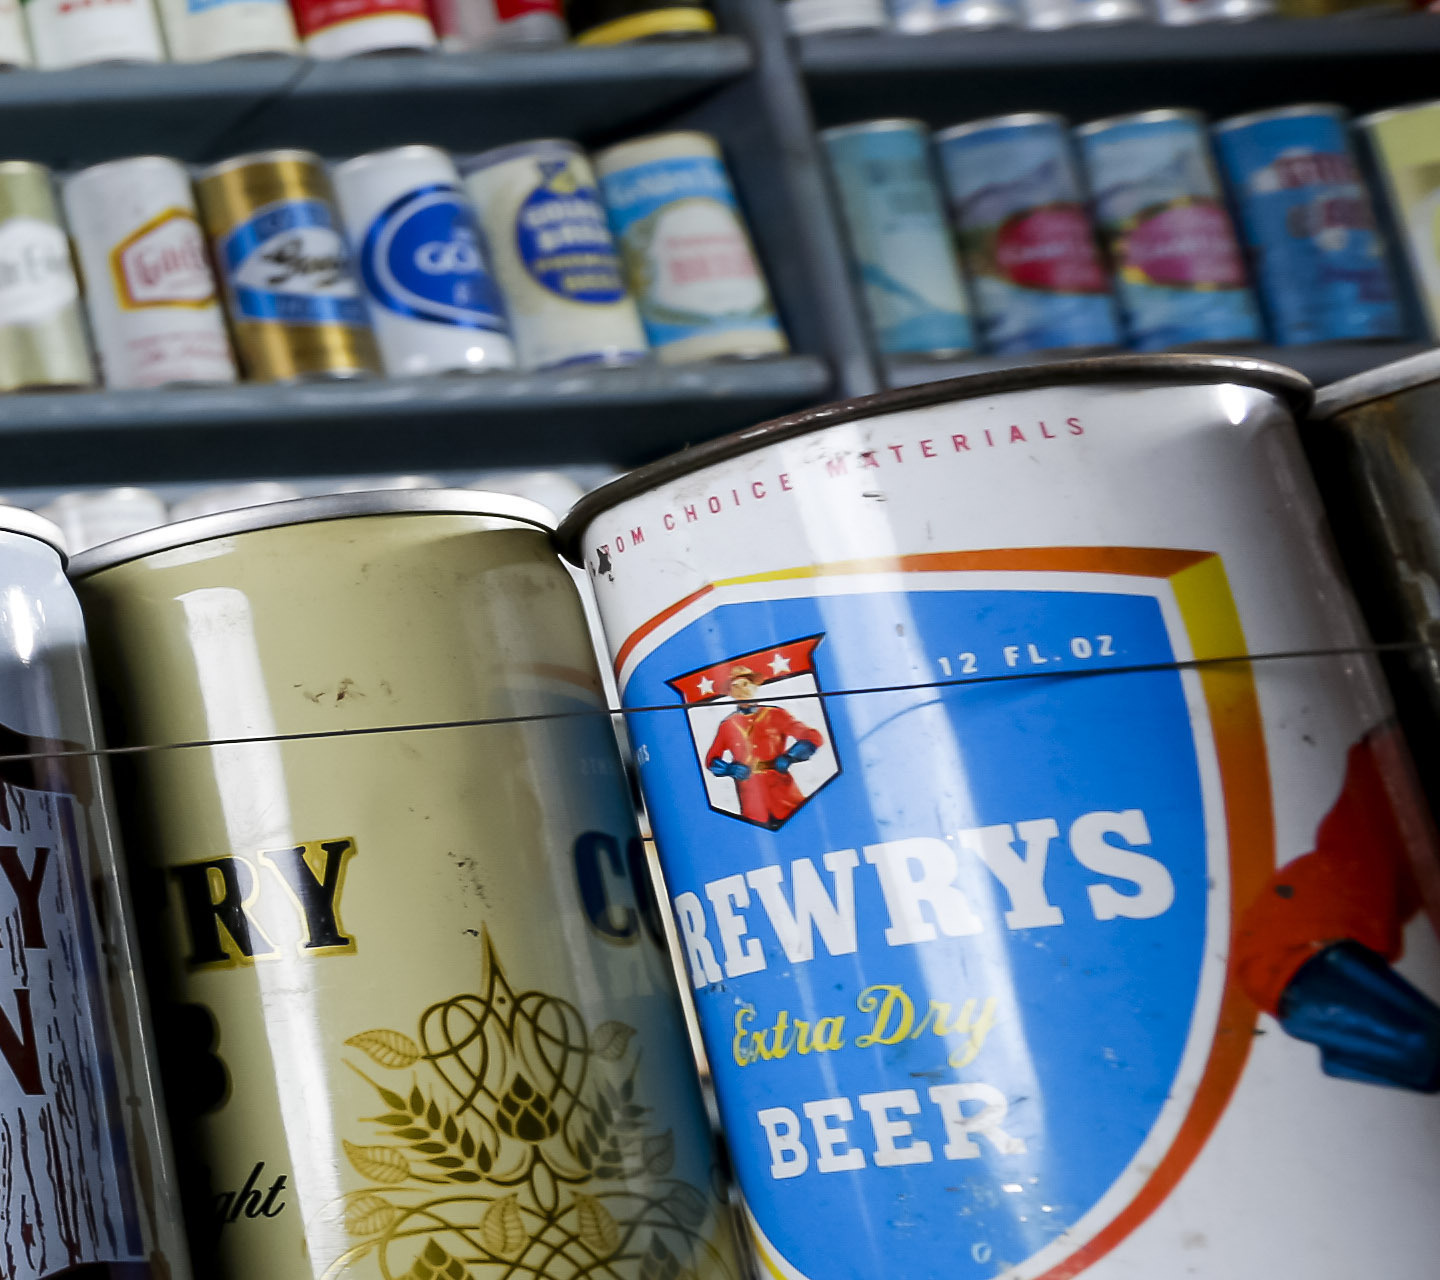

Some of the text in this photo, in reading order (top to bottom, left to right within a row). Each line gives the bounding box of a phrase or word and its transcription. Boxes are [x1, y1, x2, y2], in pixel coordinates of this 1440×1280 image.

[663, 415, 1087, 532] CHOICE MATERIALS
[937, 650, 979, 678] 12
[673, 807, 1177, 990] REWRYS
[732, 984, 1002, 1068] Extra Dry
[759, 1082, 1027, 1180] BEER
